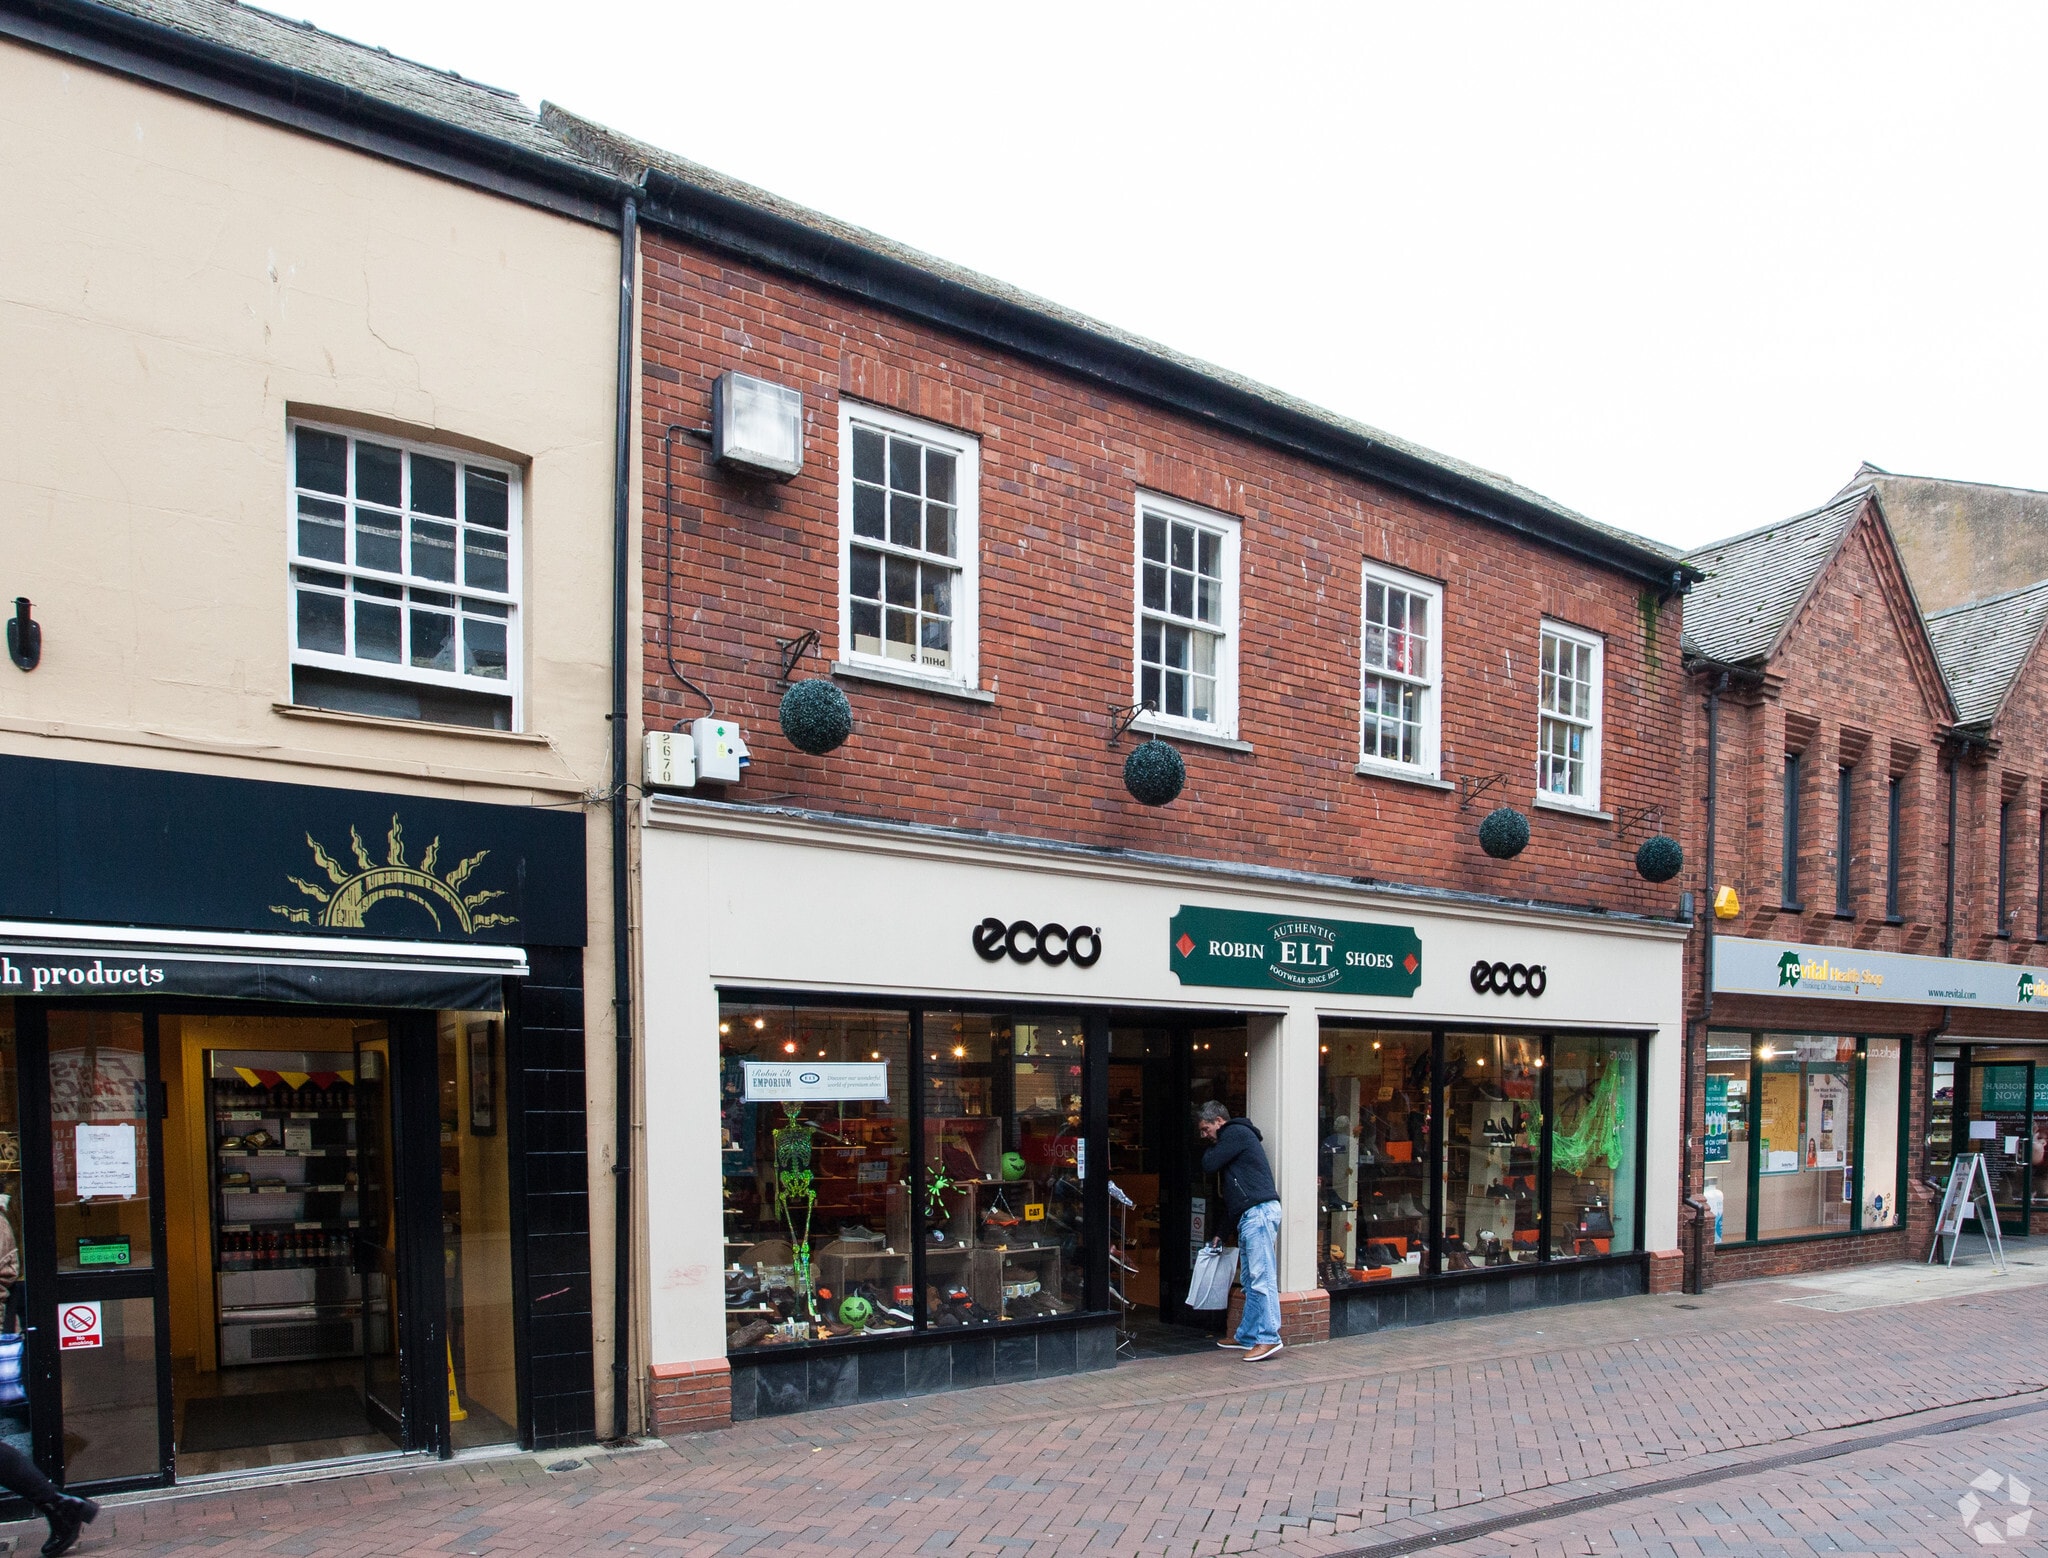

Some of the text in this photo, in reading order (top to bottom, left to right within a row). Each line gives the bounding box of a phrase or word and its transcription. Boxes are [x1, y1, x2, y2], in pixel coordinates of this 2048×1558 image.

[910, 653, 946, 667] PHILIS
[1274, 923, 1336, 941] AUTHENTIC
[972, 917, 1102, 969] ecco
[1209, 940, 1394, 969] ROBIN ELT SHOES
[0, 957, 165, 992] h products
[1269, 965, 1307, 984] FOOTWEAR
[1307, 974, 1328, 984] SINCE
[1785, 958, 1829, 981] revital
[1470, 960, 1547, 998] ecco
[2022, 978, 2048, 997] revita
[1928, 988, 1977, 1000] www.revital.com
[753, 1078, 792, 1088] EMPORIUM
[1994, 1091, 2023, 1100] NOW
[1043, 1143, 1077, 1158] SHOES
[1028, 1208, 1040, 1216] CAT
